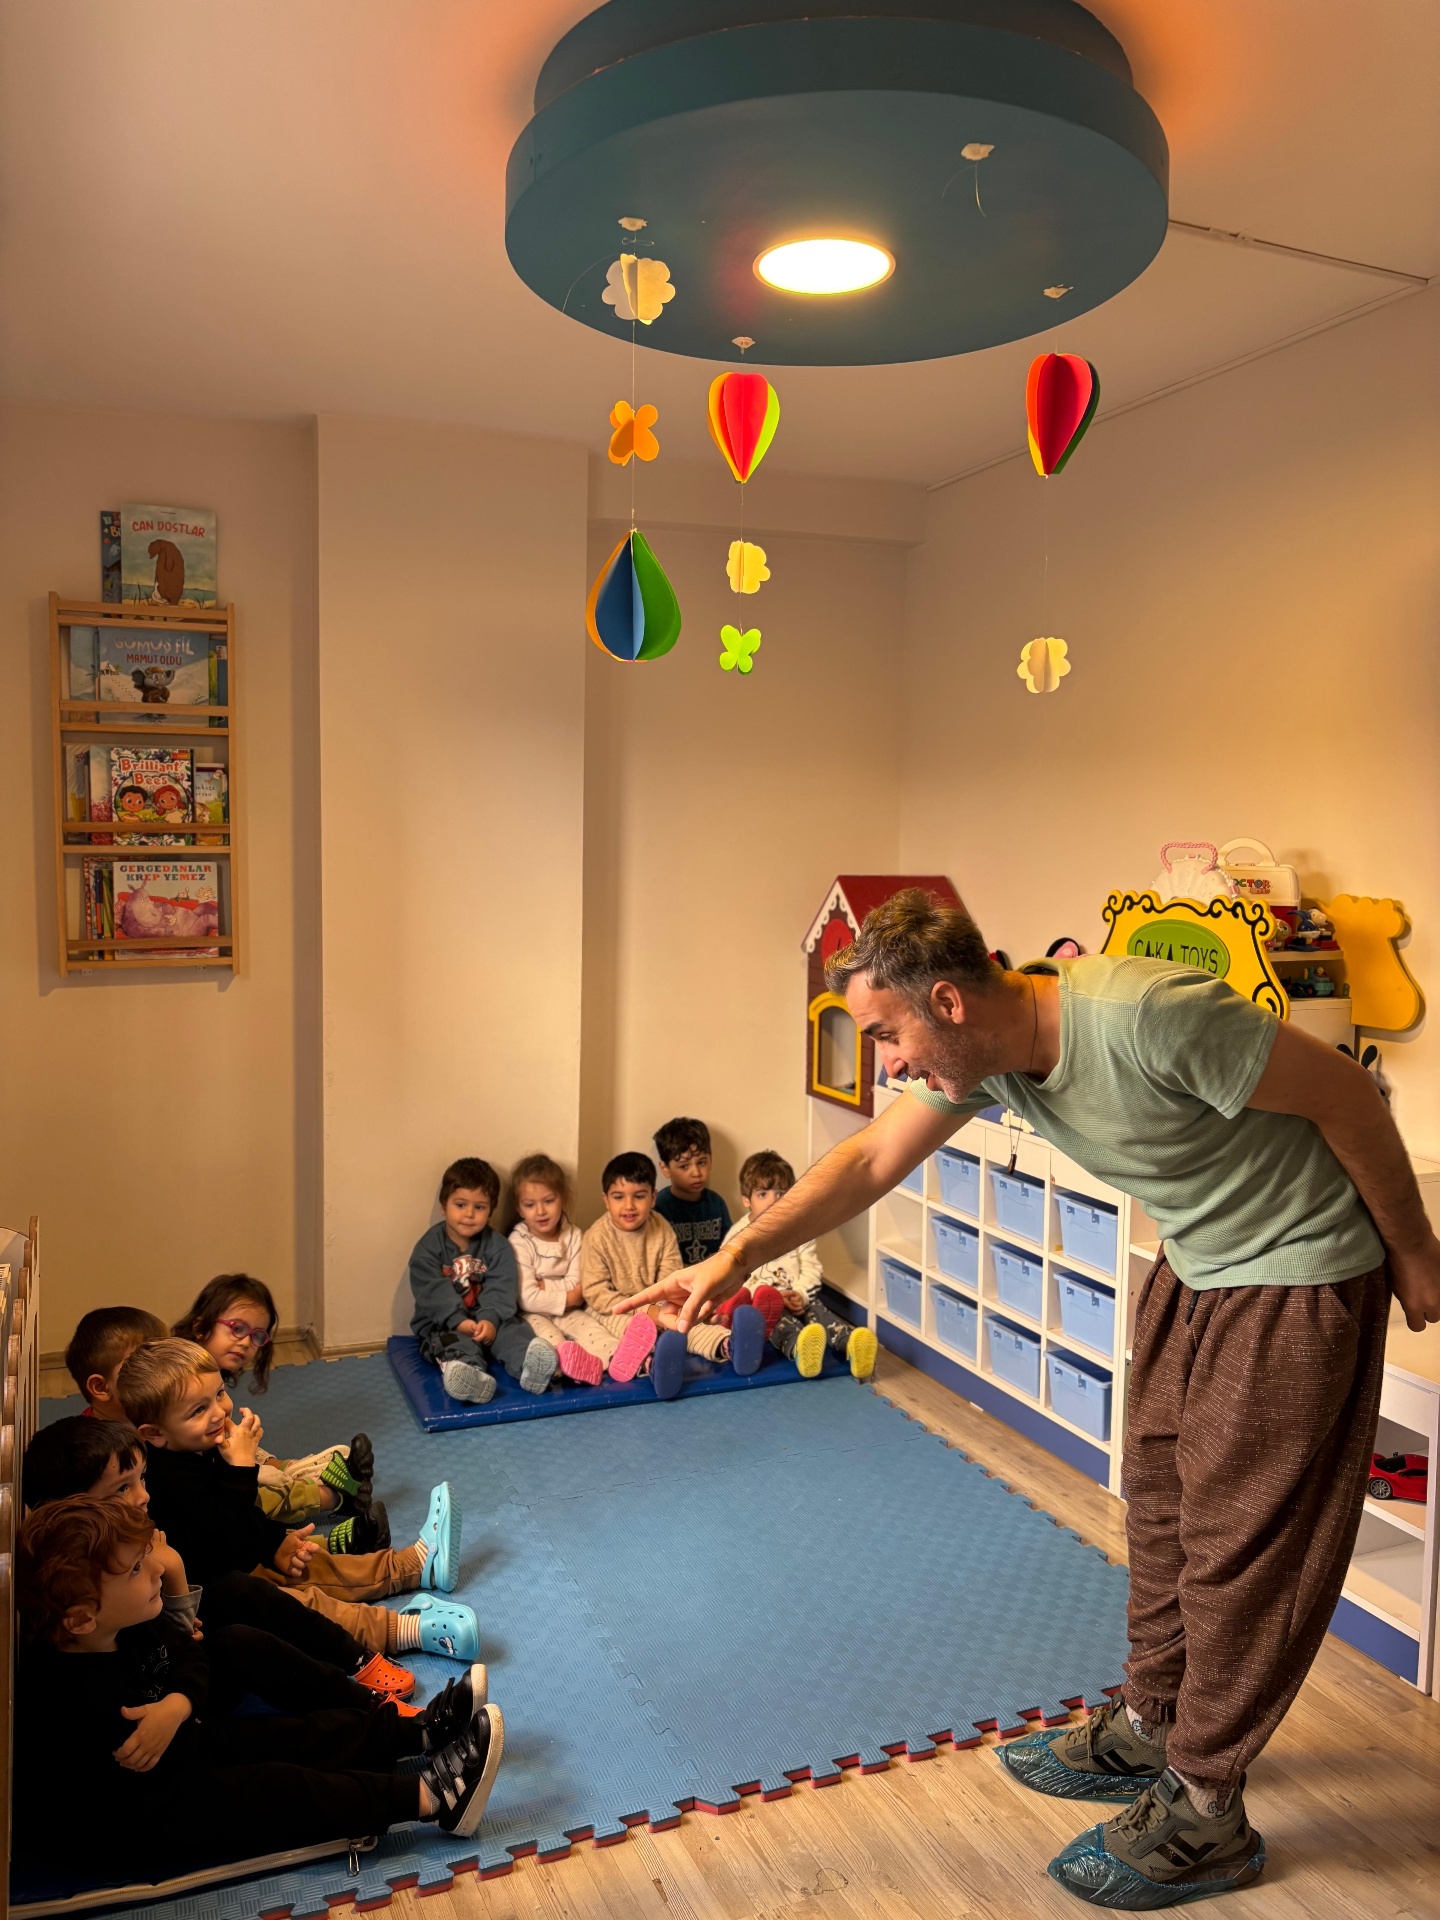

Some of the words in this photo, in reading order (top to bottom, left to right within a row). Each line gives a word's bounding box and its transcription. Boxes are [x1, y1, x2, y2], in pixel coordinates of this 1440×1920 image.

[132, 520, 154, 532] CAN
[157, 521, 206, 538] DOSTLAR
[126, 653, 158, 664] MAMUT
[160, 655, 182, 666] OLDU
[120, 758, 180, 773] Brilliant
[133, 772, 168, 785] Bees
[119, 864, 212, 873] GERGEDANLAR
[126, 873, 160, 881] KREP
[164, 873, 206, 881] YEMEZ
[1232, 878, 1271, 889] OCTOR
[1180, 944, 1219, 974] TOYS
